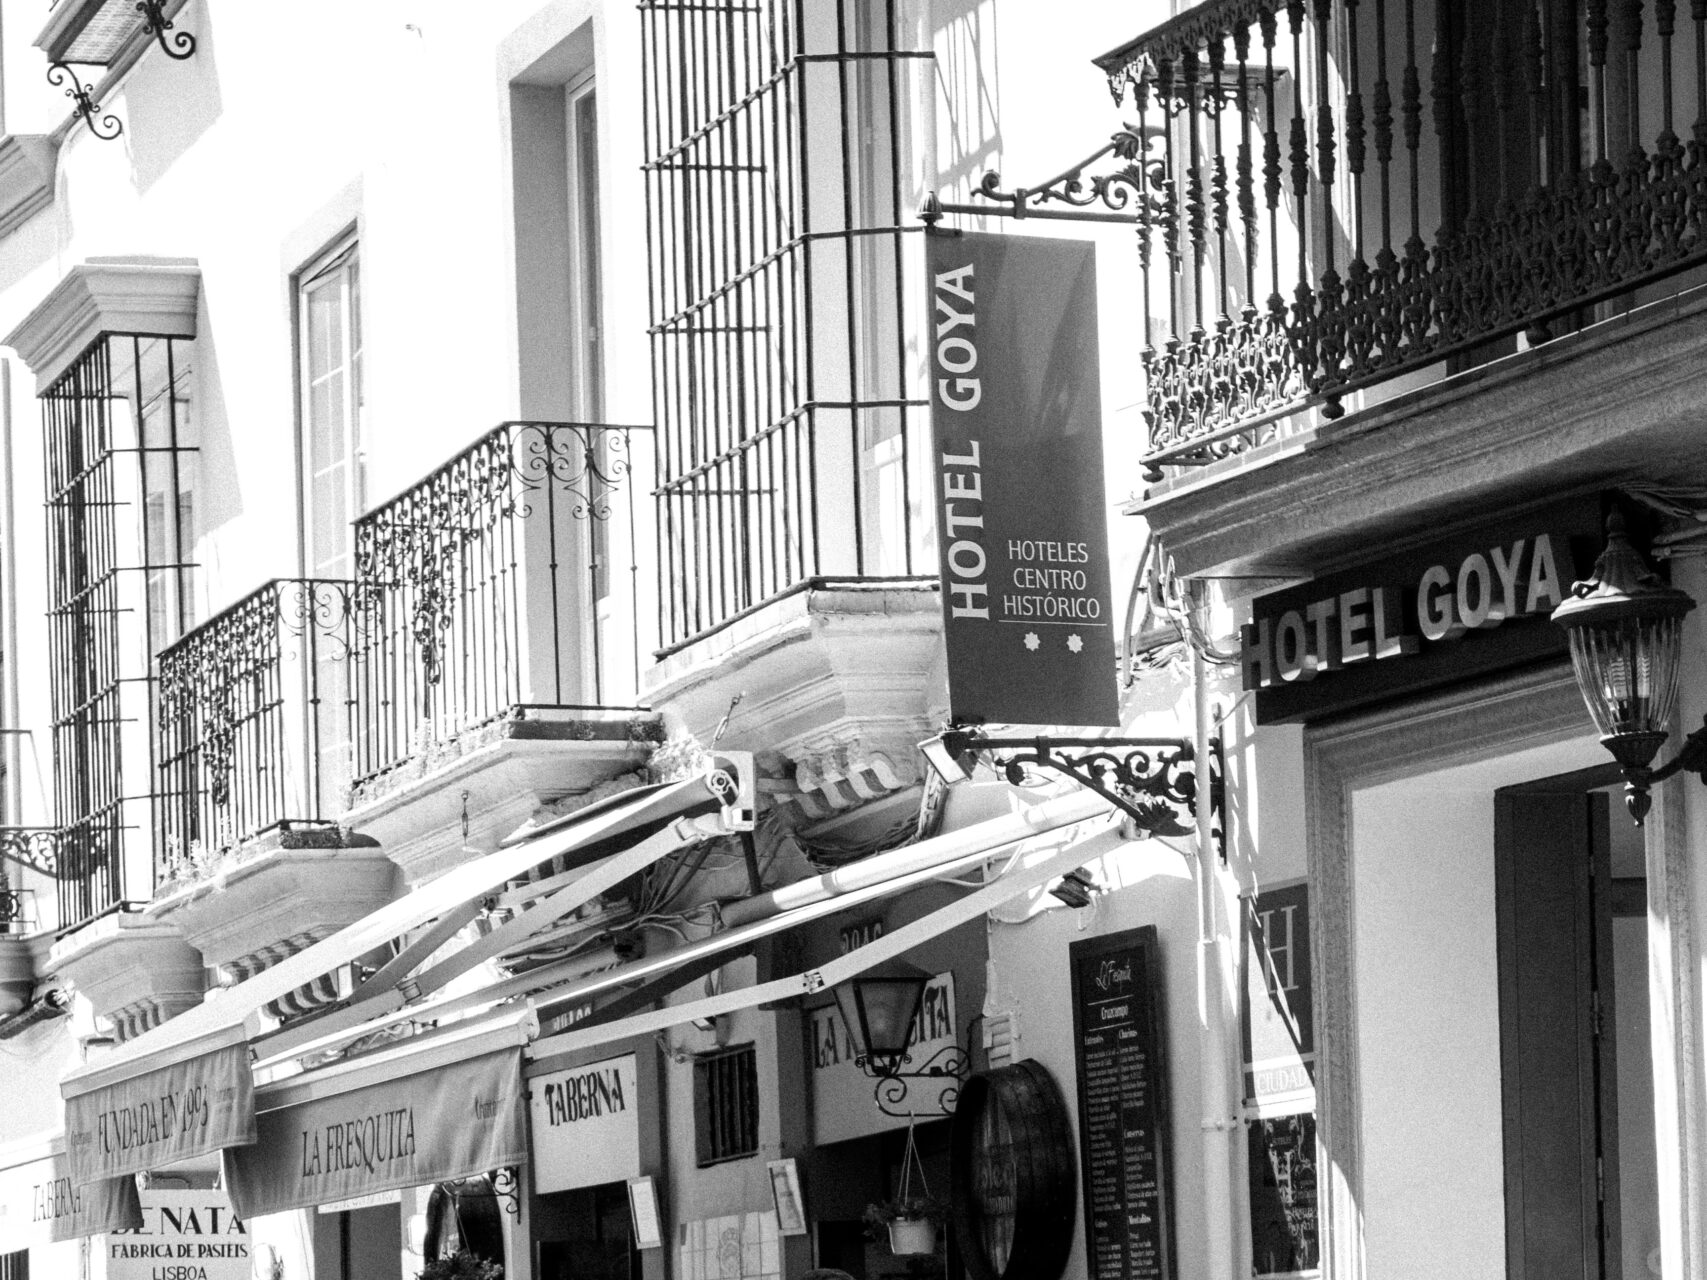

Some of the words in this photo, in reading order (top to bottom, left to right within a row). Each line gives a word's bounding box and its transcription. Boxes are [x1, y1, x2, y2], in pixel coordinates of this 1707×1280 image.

[935, 263, 983, 412] GOYA
[942, 440, 990, 621] HOTEL
[1008, 539, 1089, 563] HOTELES
[1013, 567, 1087, 591] CENTRO
[1003, 591, 1100, 618] HISTÓRICO
[1241, 586, 1402, 691] HOTEL
[1417, 533, 1563, 641] GOYA
[1258, 905, 1299, 994] H
[812, 1016, 840, 1069] LA
[544, 1068, 626, 1127] TABERNA
[1257, 1065, 1308, 1092] CIUDAD
[99, 1101, 160, 1155] FUNDADA
[160, 1091, 179, 1140] EN
[302, 1130, 322, 1177] LA
[326, 1106, 416, 1174] FRESQUITA
[33, 1176, 81, 1222] TABERNA
[111, 1207, 153, 1235] E
[160, 1206, 247, 1235] NATA
[152, 1265, 208, 1280] LISBOA
[177, 1244, 194, 1258] DE
